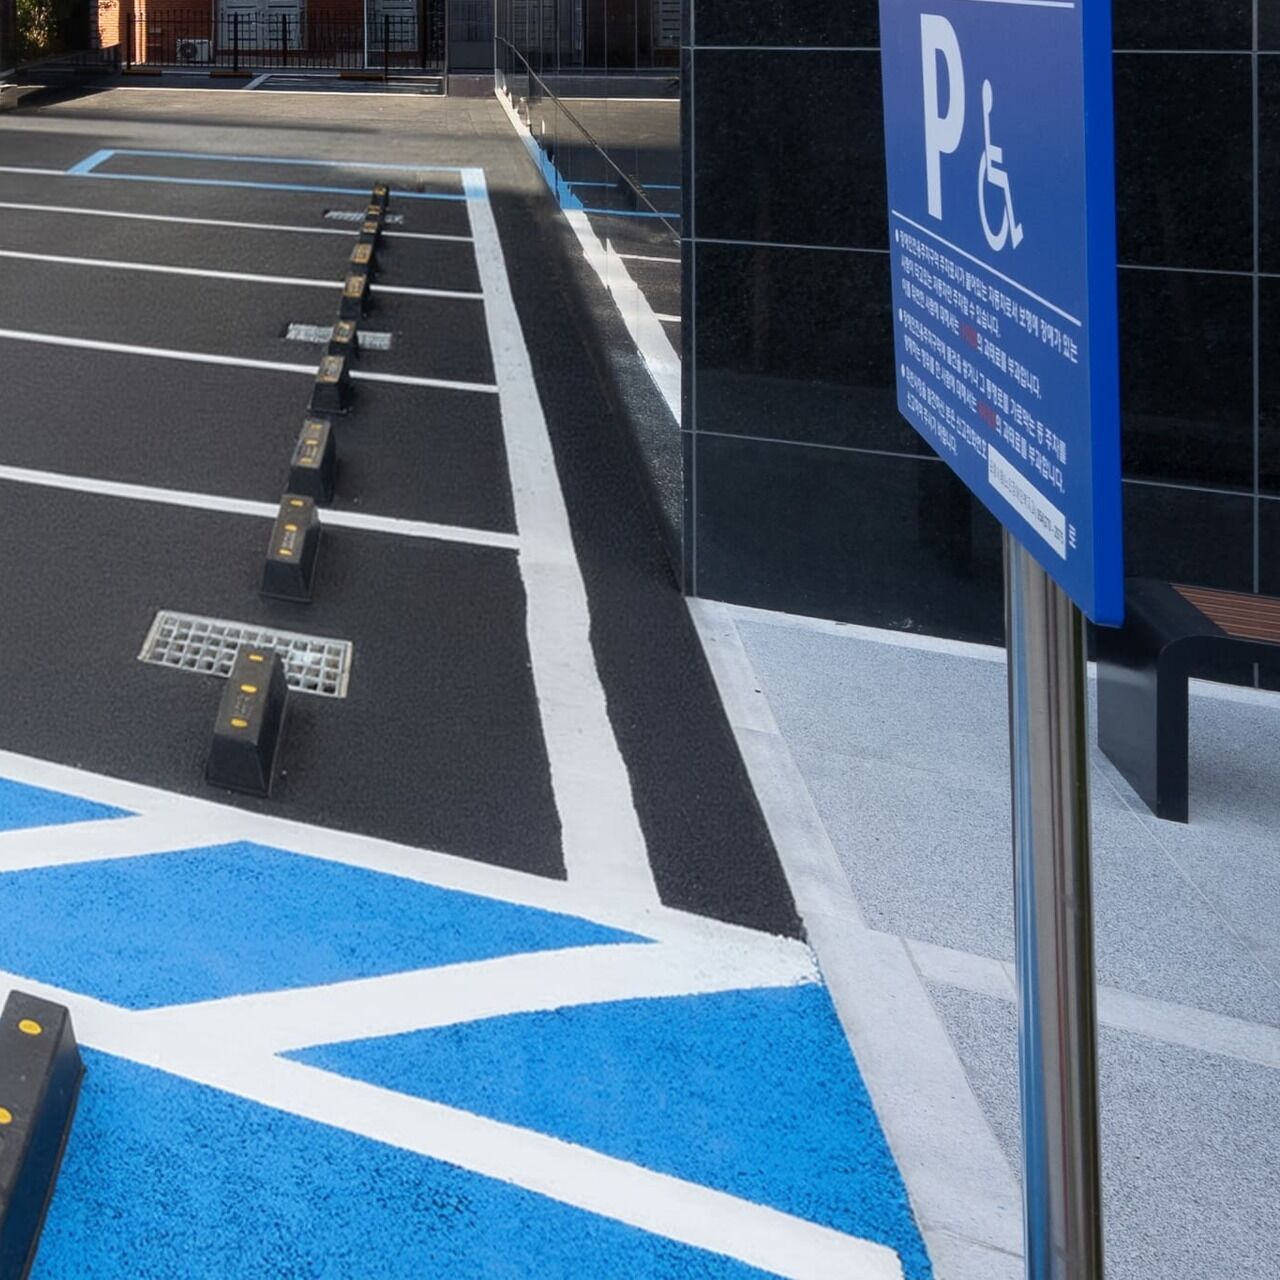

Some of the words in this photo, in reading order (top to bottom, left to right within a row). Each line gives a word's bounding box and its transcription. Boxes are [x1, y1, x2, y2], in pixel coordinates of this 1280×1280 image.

[920, 12, 965, 220] P
[988, 287, 1017, 322] 자동차로서
[1019, 307, 1038, 337] 보행에
[1040, 321, 1061, 352] 장애가
[1063, 336, 1078, 364] 있는
[984, 340, 1007, 372] 과태료를
[1003, 423, 1027, 460] 과태료를
[1045, 429, 1066, 465] 주차를
